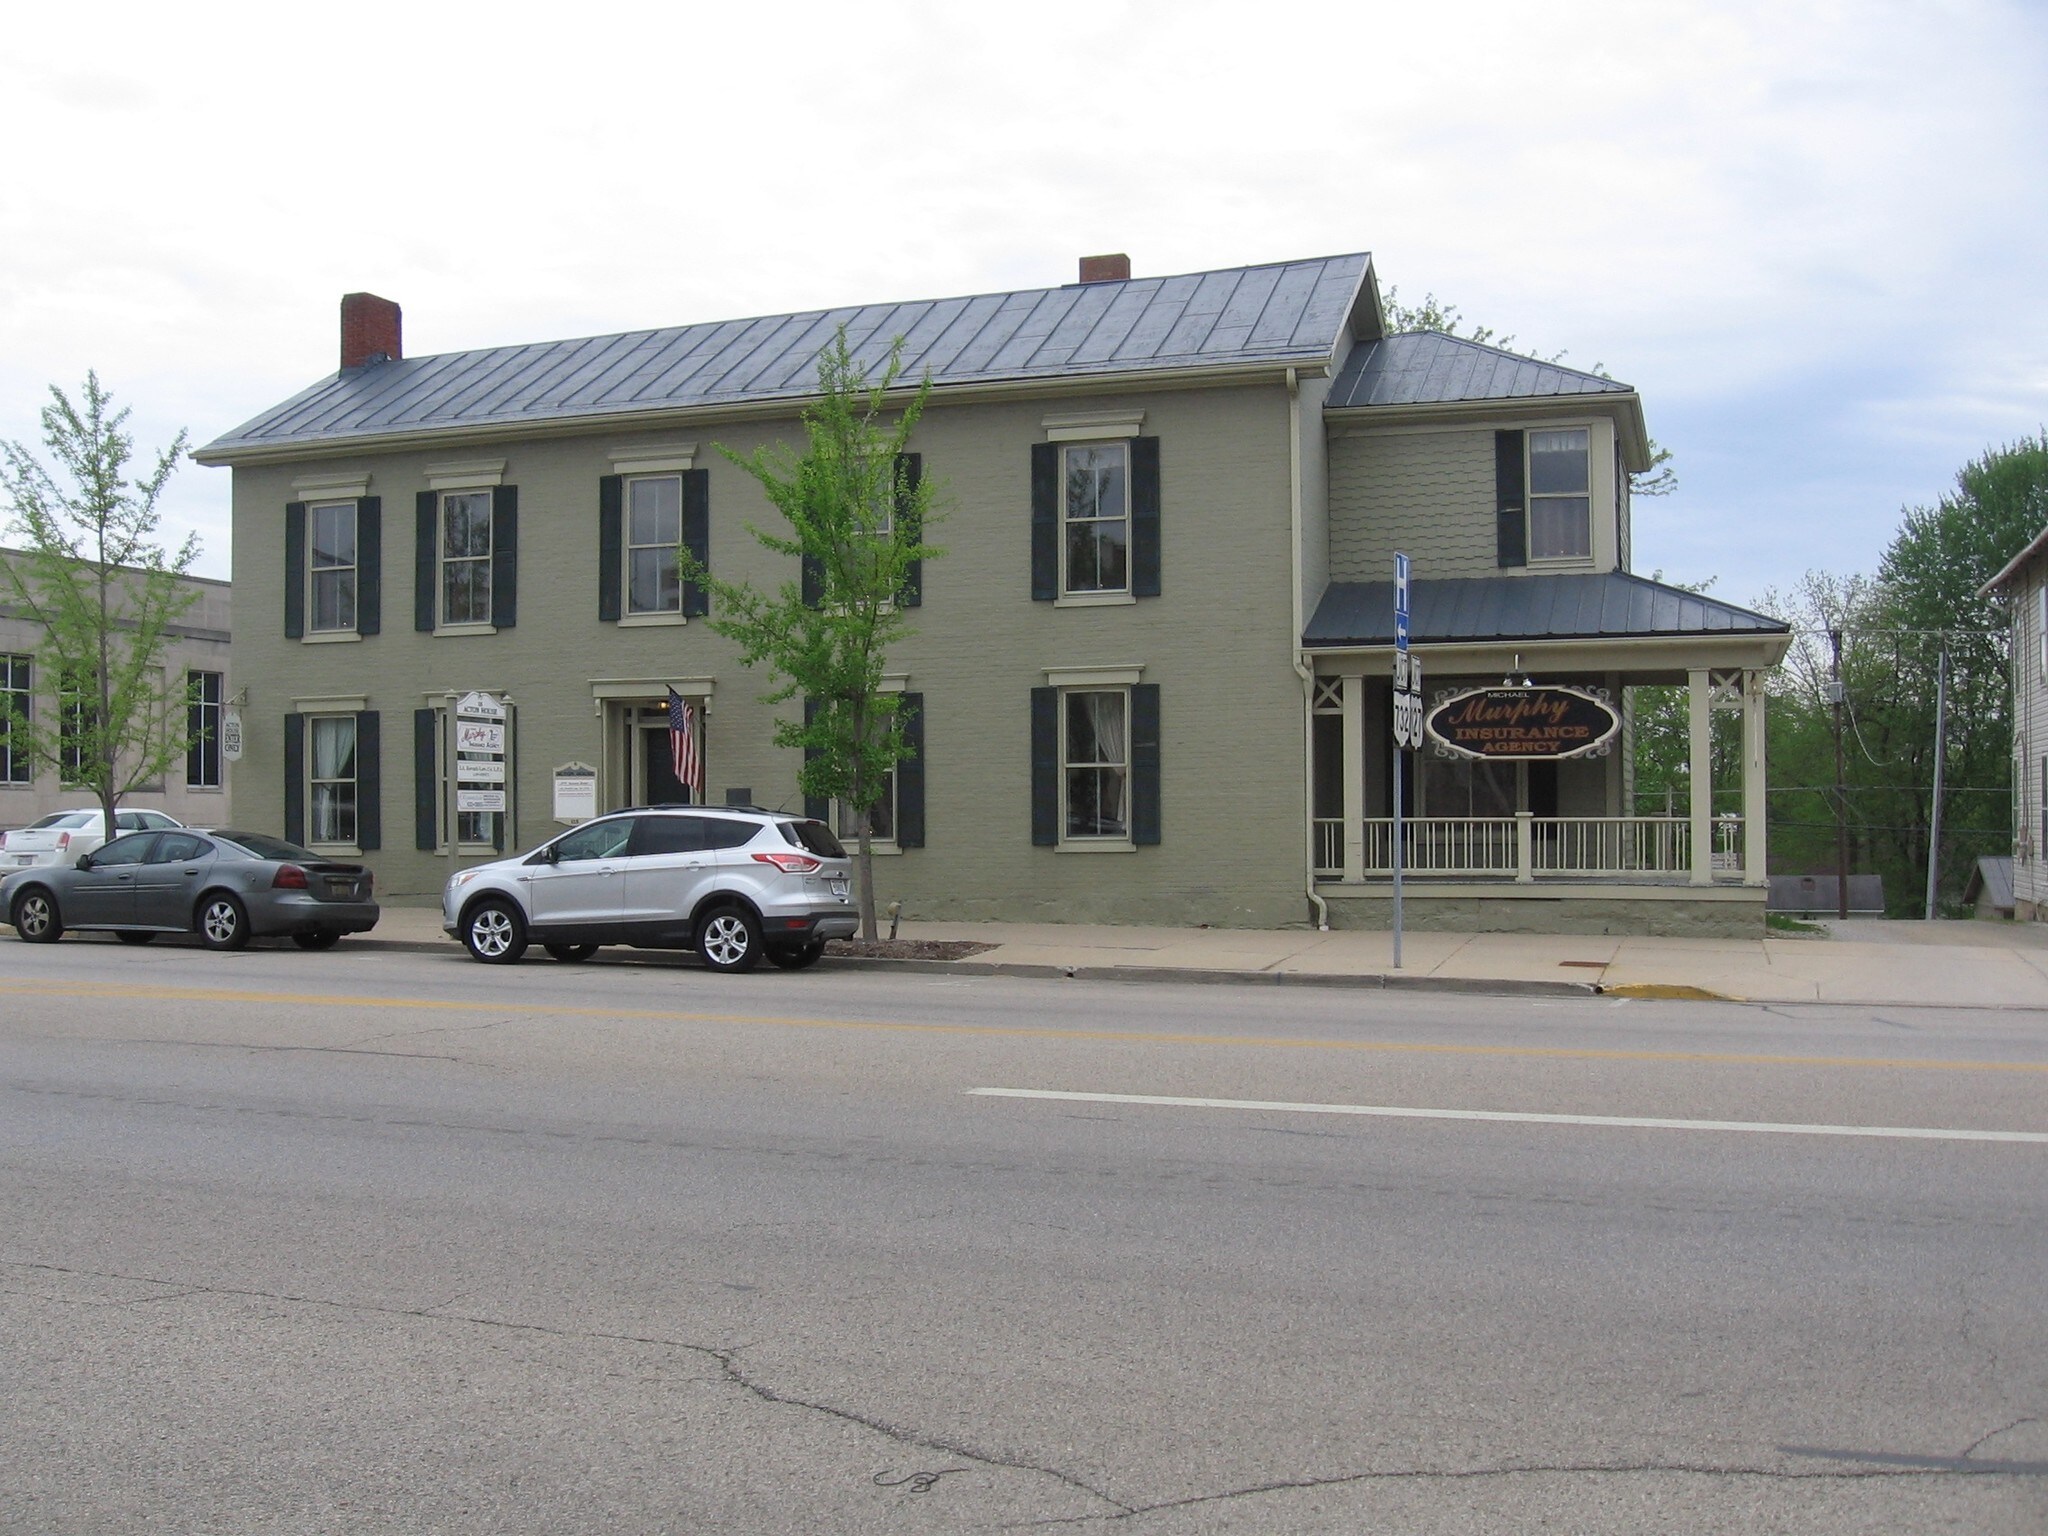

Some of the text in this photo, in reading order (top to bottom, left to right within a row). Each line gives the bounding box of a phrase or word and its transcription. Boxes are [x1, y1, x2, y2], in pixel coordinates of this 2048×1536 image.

[1396, 555, 1407, 612] H
[1448, 692, 1570, 725] Murphy
[1455, 726, 1590, 740] INSURANCE
[1481, 741, 1561, 752] AGENCY
